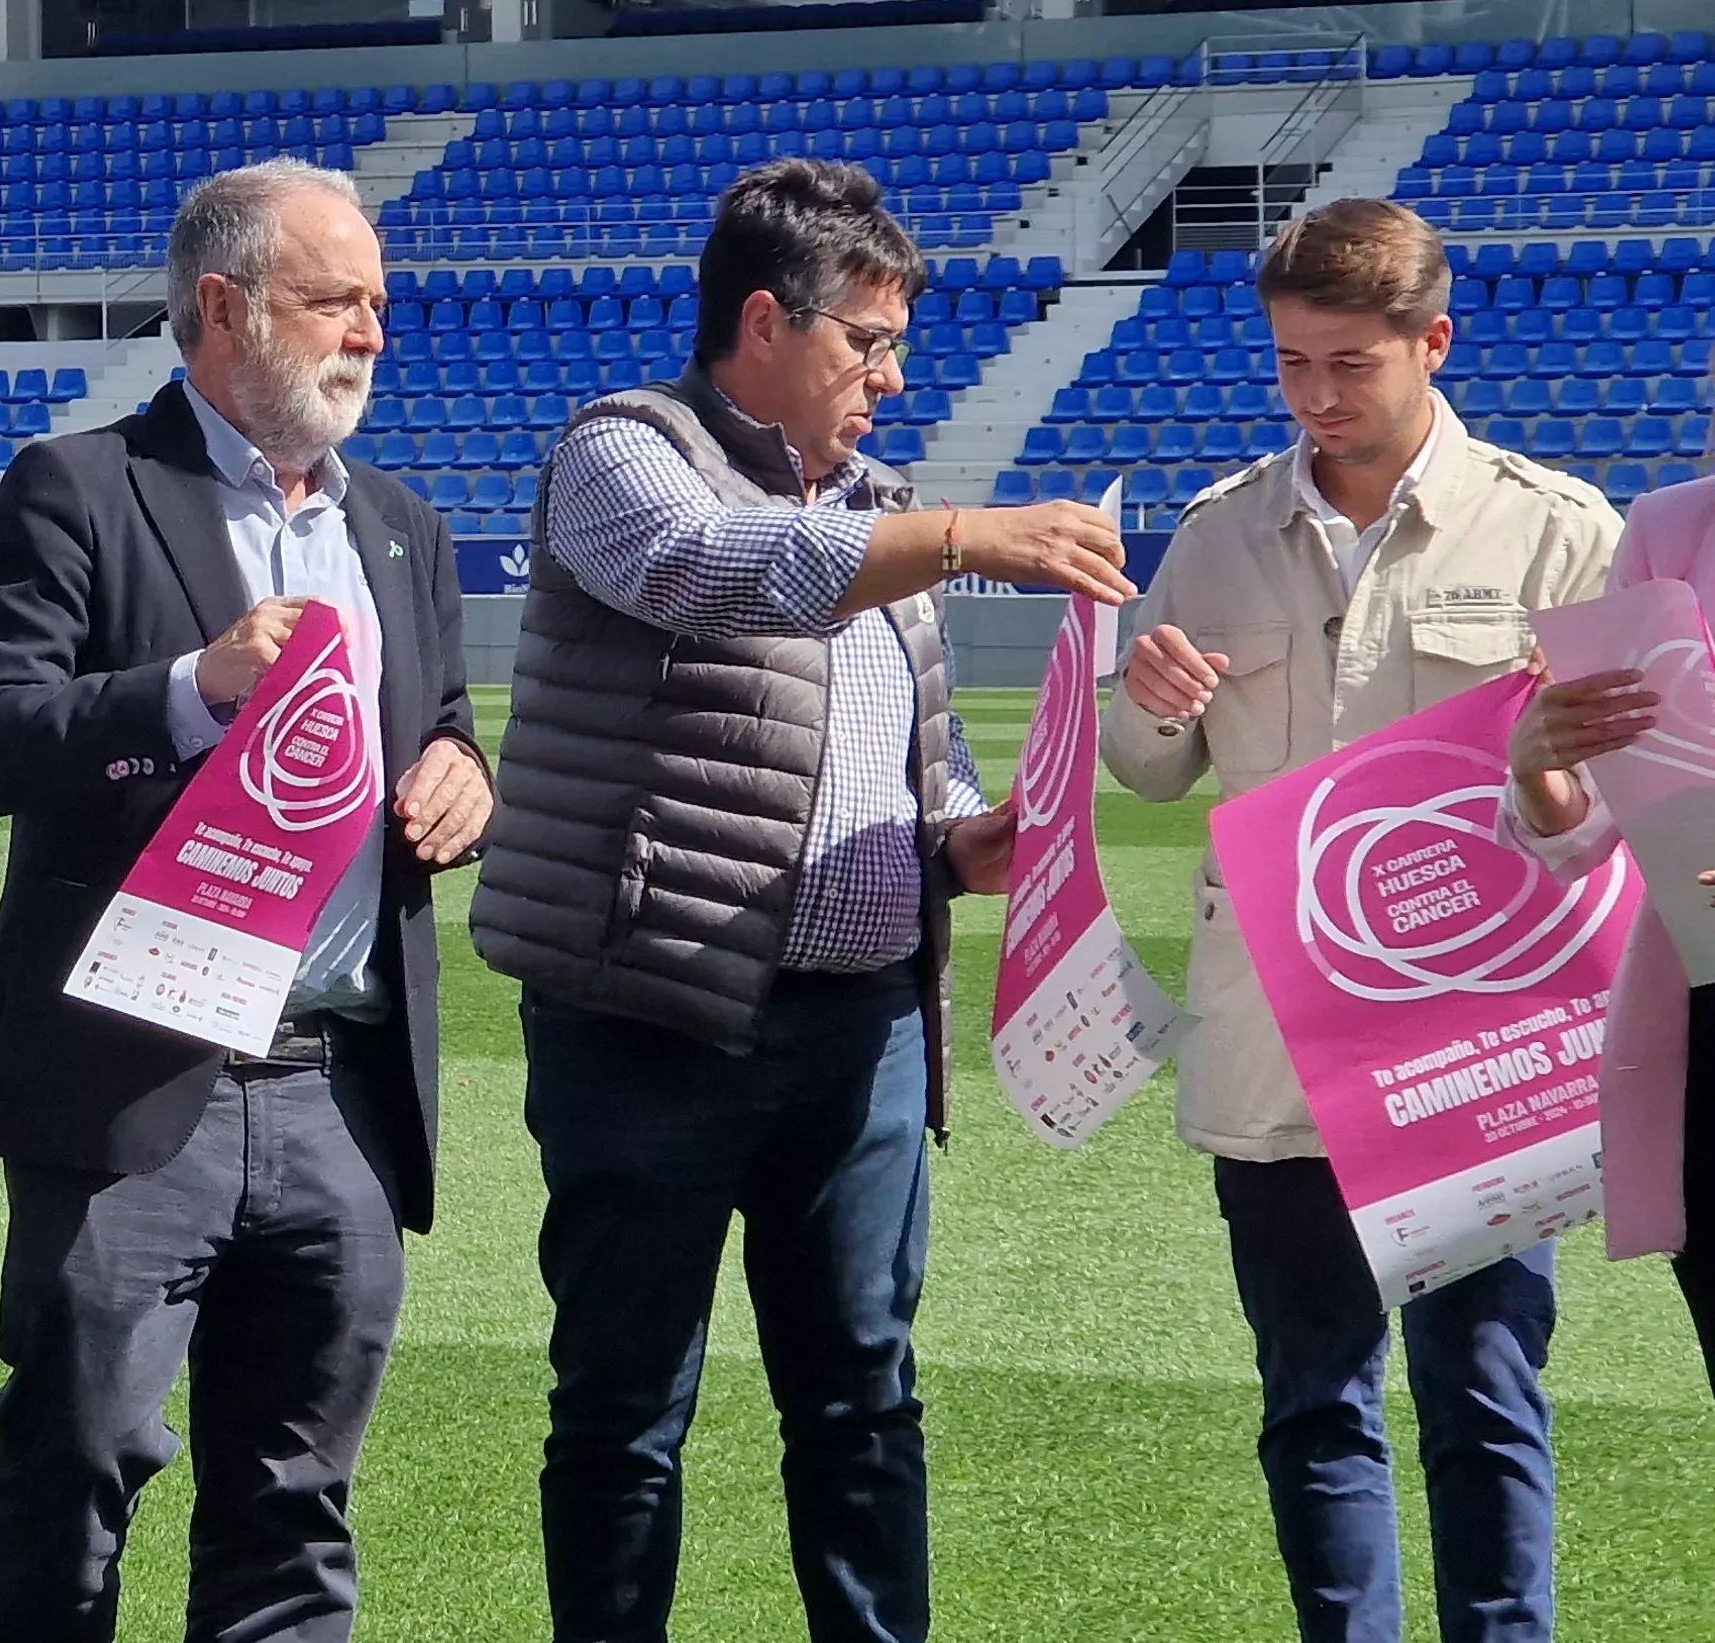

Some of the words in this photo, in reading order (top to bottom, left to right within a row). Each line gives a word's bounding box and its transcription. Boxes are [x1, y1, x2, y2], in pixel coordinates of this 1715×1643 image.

[176, 839, 259, 884] CAMINEMOS
[251, 865, 304, 900] JUNTOS
[1371, 864, 1387, 878] X
[1388, 838, 1459, 872] CARRERA
[1377, 854, 1467, 898] HUESCA
[1387, 886, 1452, 918] CONTRA
[1452, 878, 1475, 896] EL
[1392, 891, 1481, 934] CANCER
[1372, 1068, 1394, 1088] Te
[1477, 1030, 1501, 1050] Te
[1570, 997, 1591, 1017] Te
[1384, 1040, 1554, 1129] CAMINEMOS
[1476, 1100, 1529, 1131] PLAZA
[1529, 1074, 1599, 1112] NAVARRA
